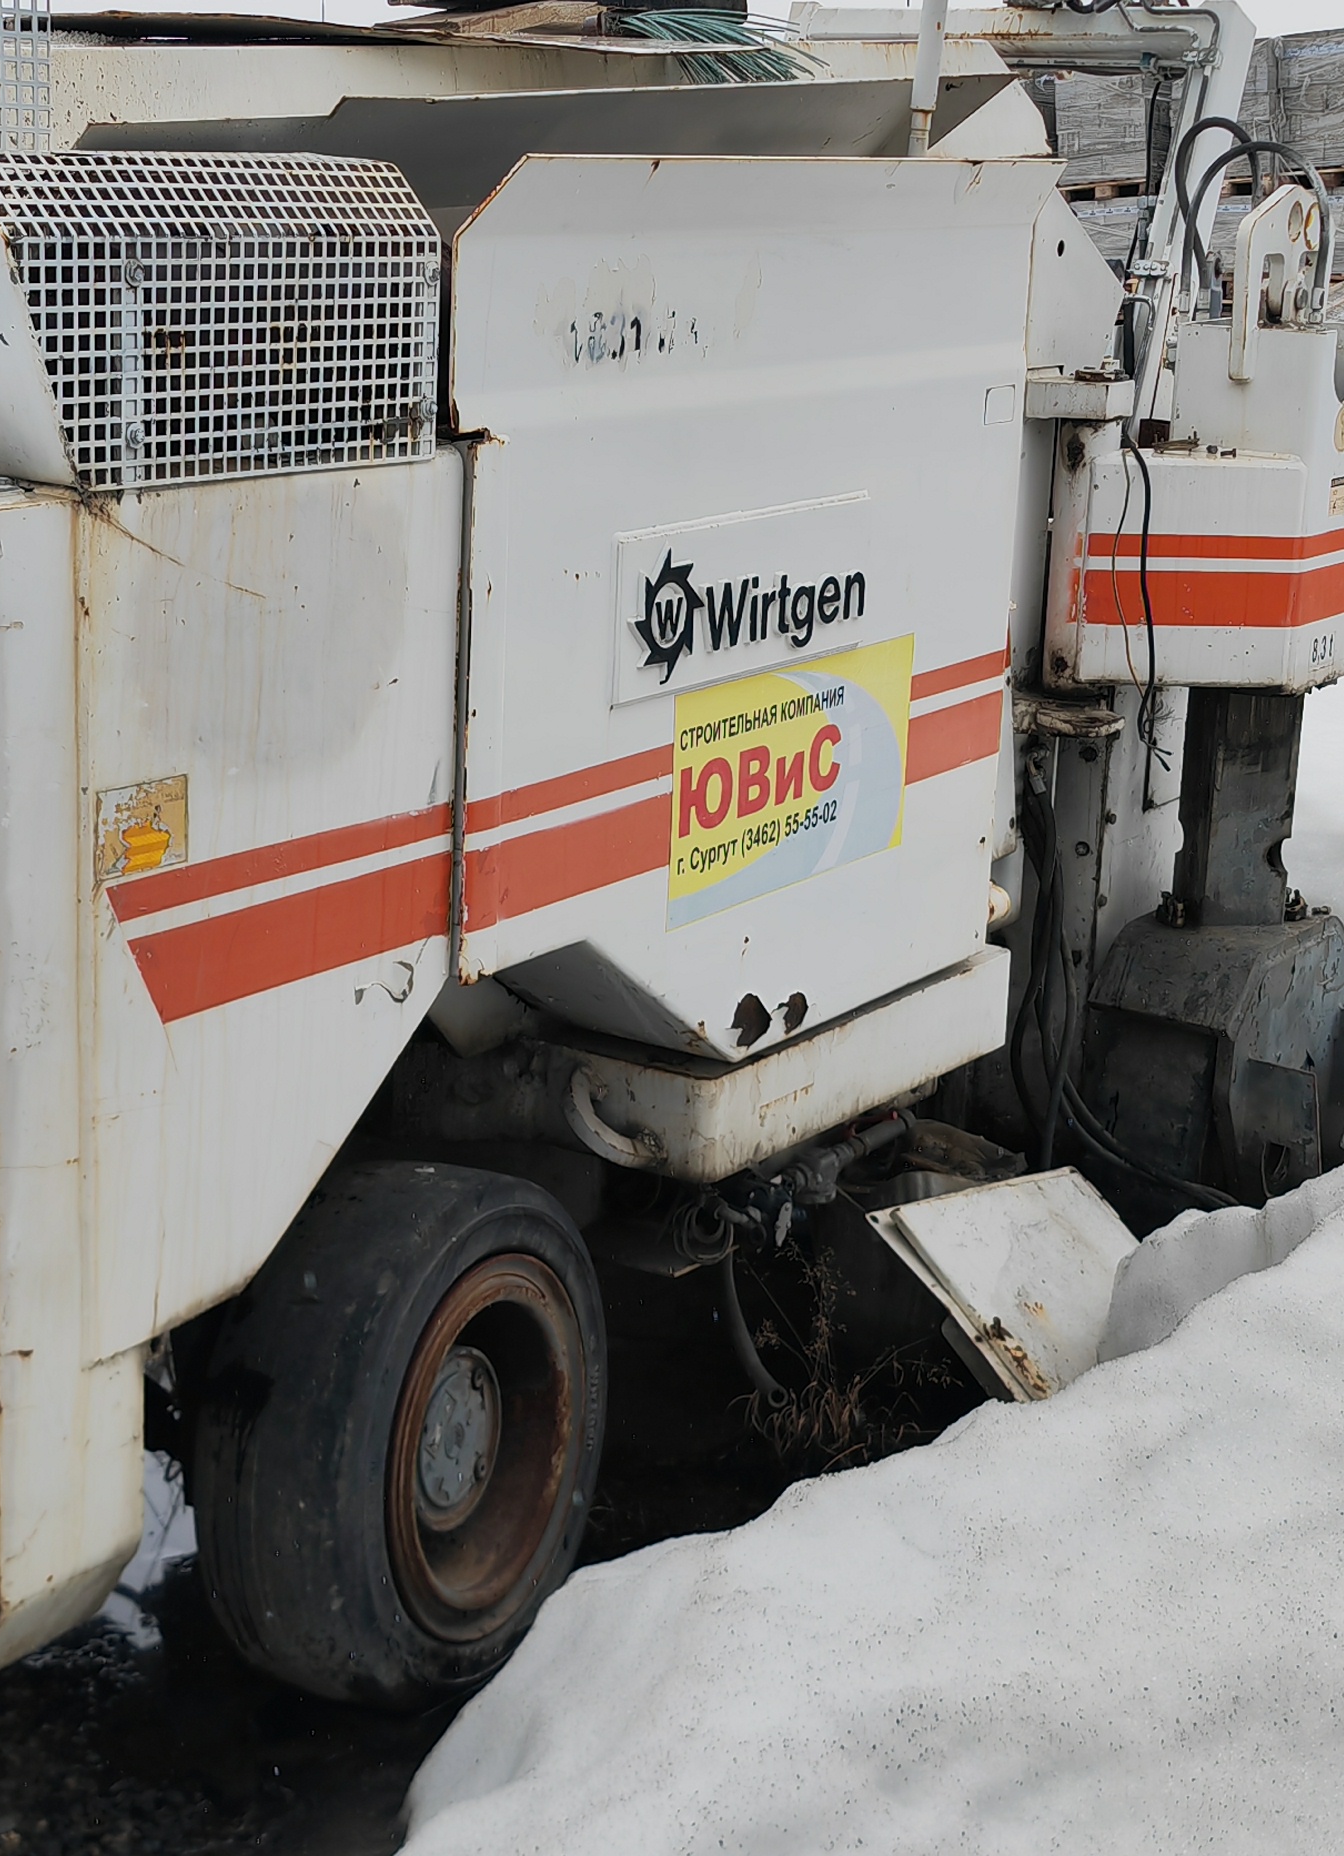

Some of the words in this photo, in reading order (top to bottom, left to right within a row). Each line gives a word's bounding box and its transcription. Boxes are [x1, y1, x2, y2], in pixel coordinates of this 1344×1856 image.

[704, 570, 866, 649] Wirtgen
[679, 704, 778, 752] СТРОИТЕЛЬНАЯ
[780, 685, 845, 723] КОМПАНИЯ
[678, 723, 843, 839] ЮВиС
[676, 858, 685, 876] г.
[689, 838, 739, 874] Сургут
[741, 818, 782, 858] (3462)
[784, 799, 838, 838] 55-55-02
